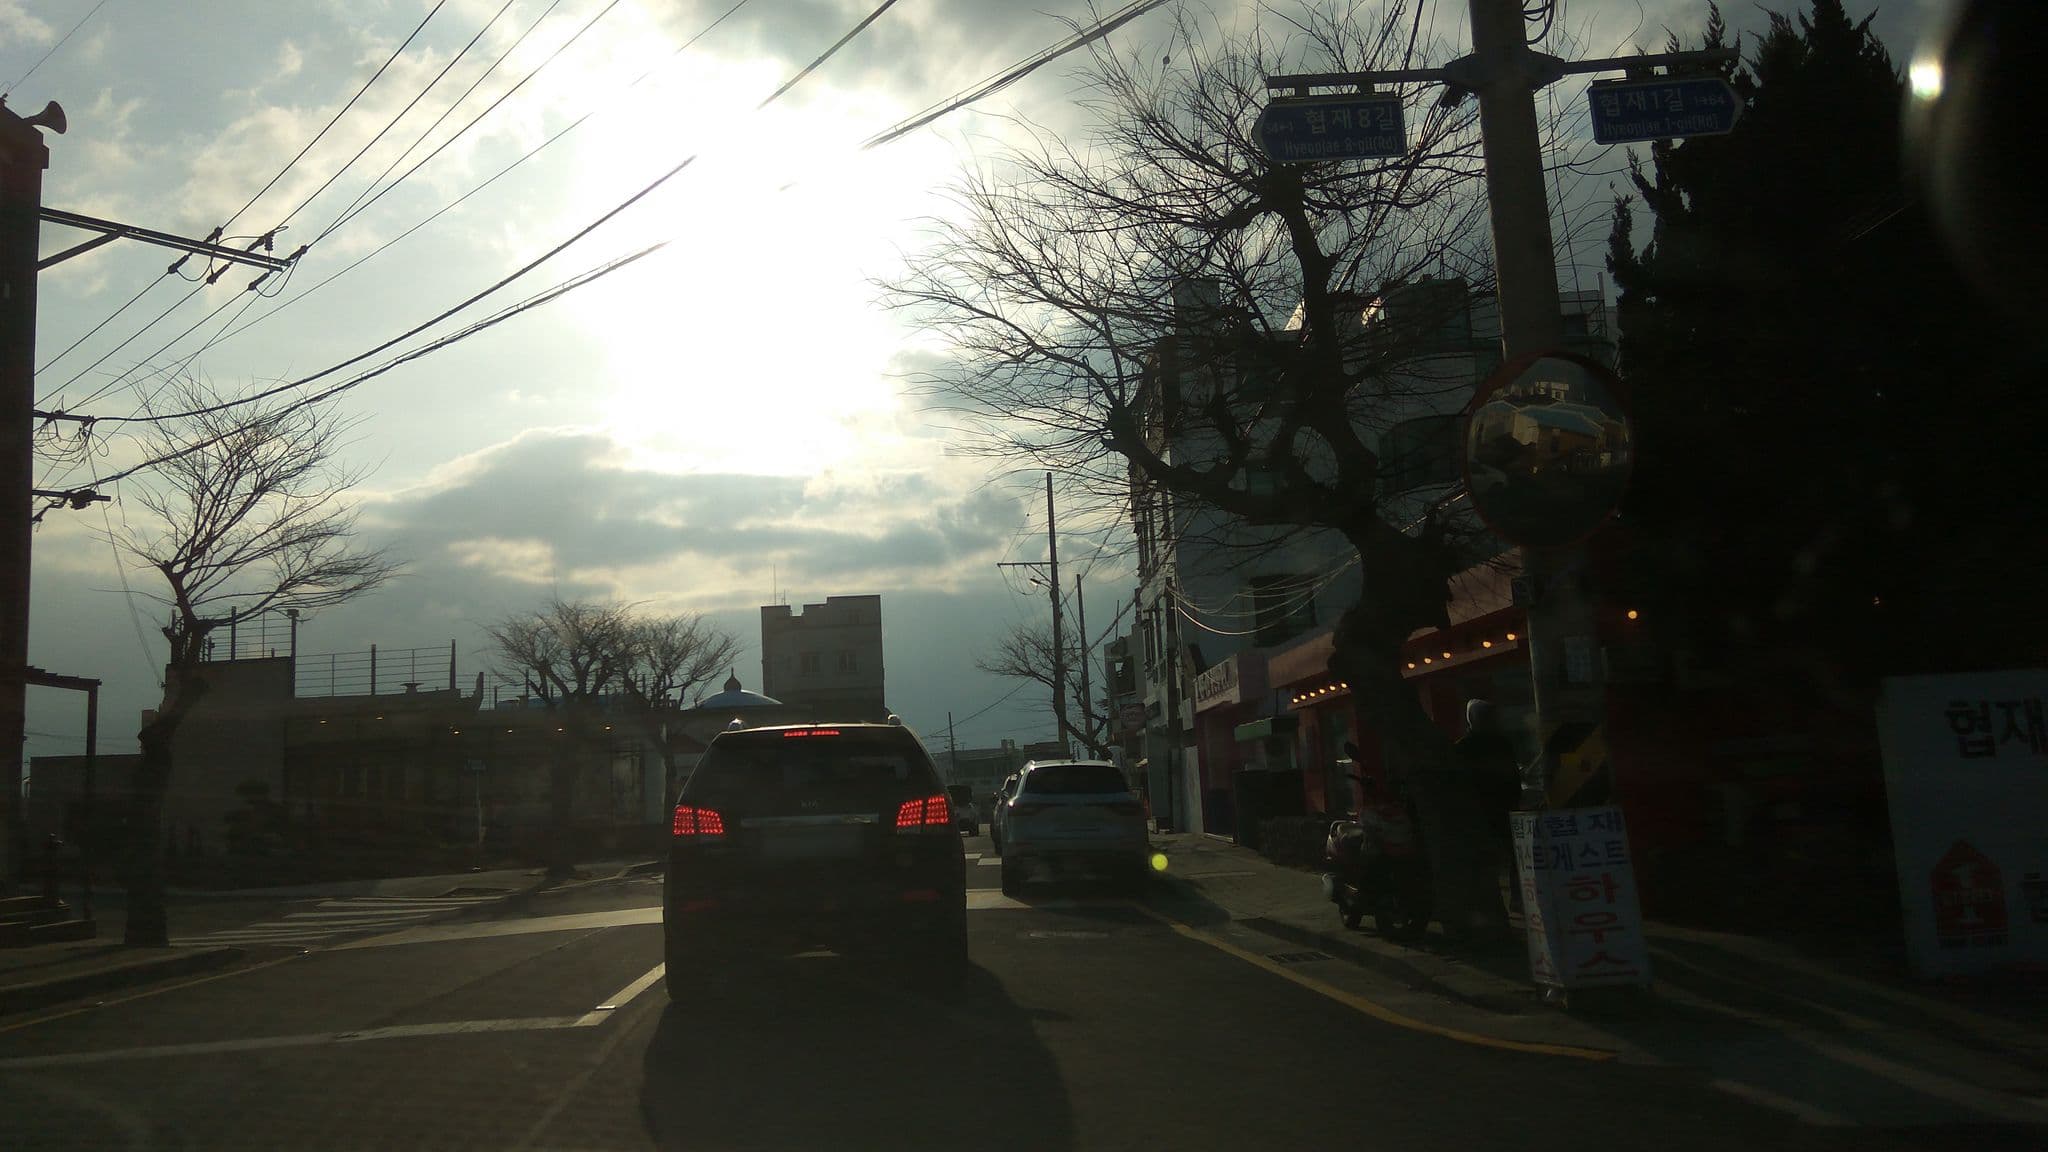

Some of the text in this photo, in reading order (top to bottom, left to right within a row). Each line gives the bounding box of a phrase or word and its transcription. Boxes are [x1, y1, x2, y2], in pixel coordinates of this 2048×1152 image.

[1598, 87, 1684, 117] 협재1길
[1304, 105, 1395, 135] 협재8길
[1944, 697, 2048, 758] 협재
[1553, 839, 1629, 872] 게스트
